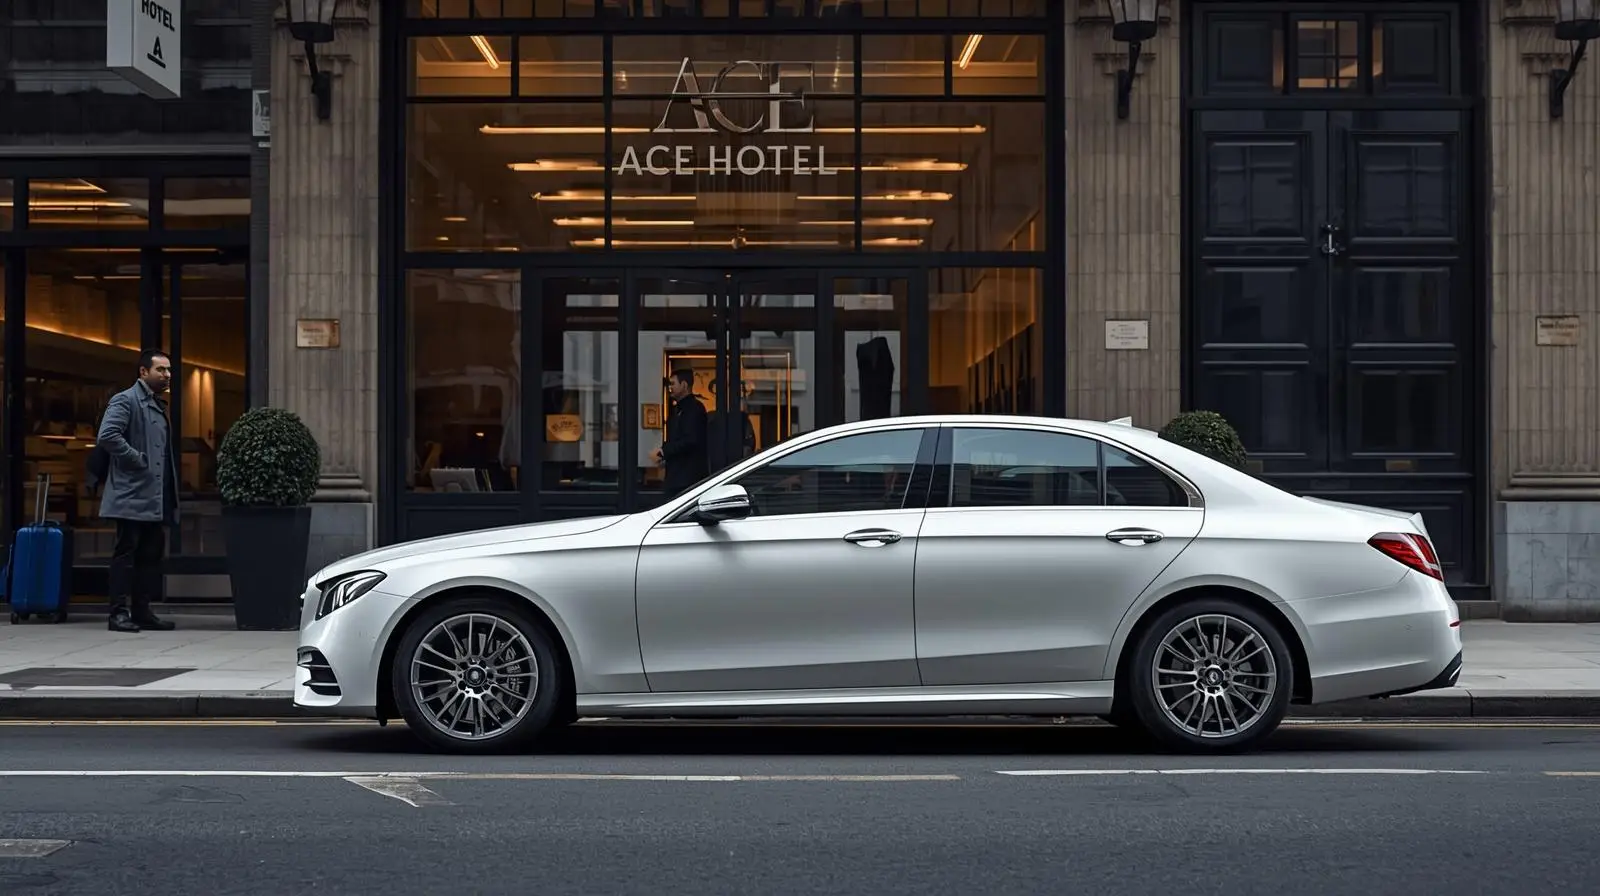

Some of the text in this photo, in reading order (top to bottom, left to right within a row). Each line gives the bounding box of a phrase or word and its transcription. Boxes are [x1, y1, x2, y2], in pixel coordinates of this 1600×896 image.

[142, 0, 175, 32] HOTEL
[652, 57, 814, 133] ACE
[617, 145, 838, 176] ACE HOTEL
